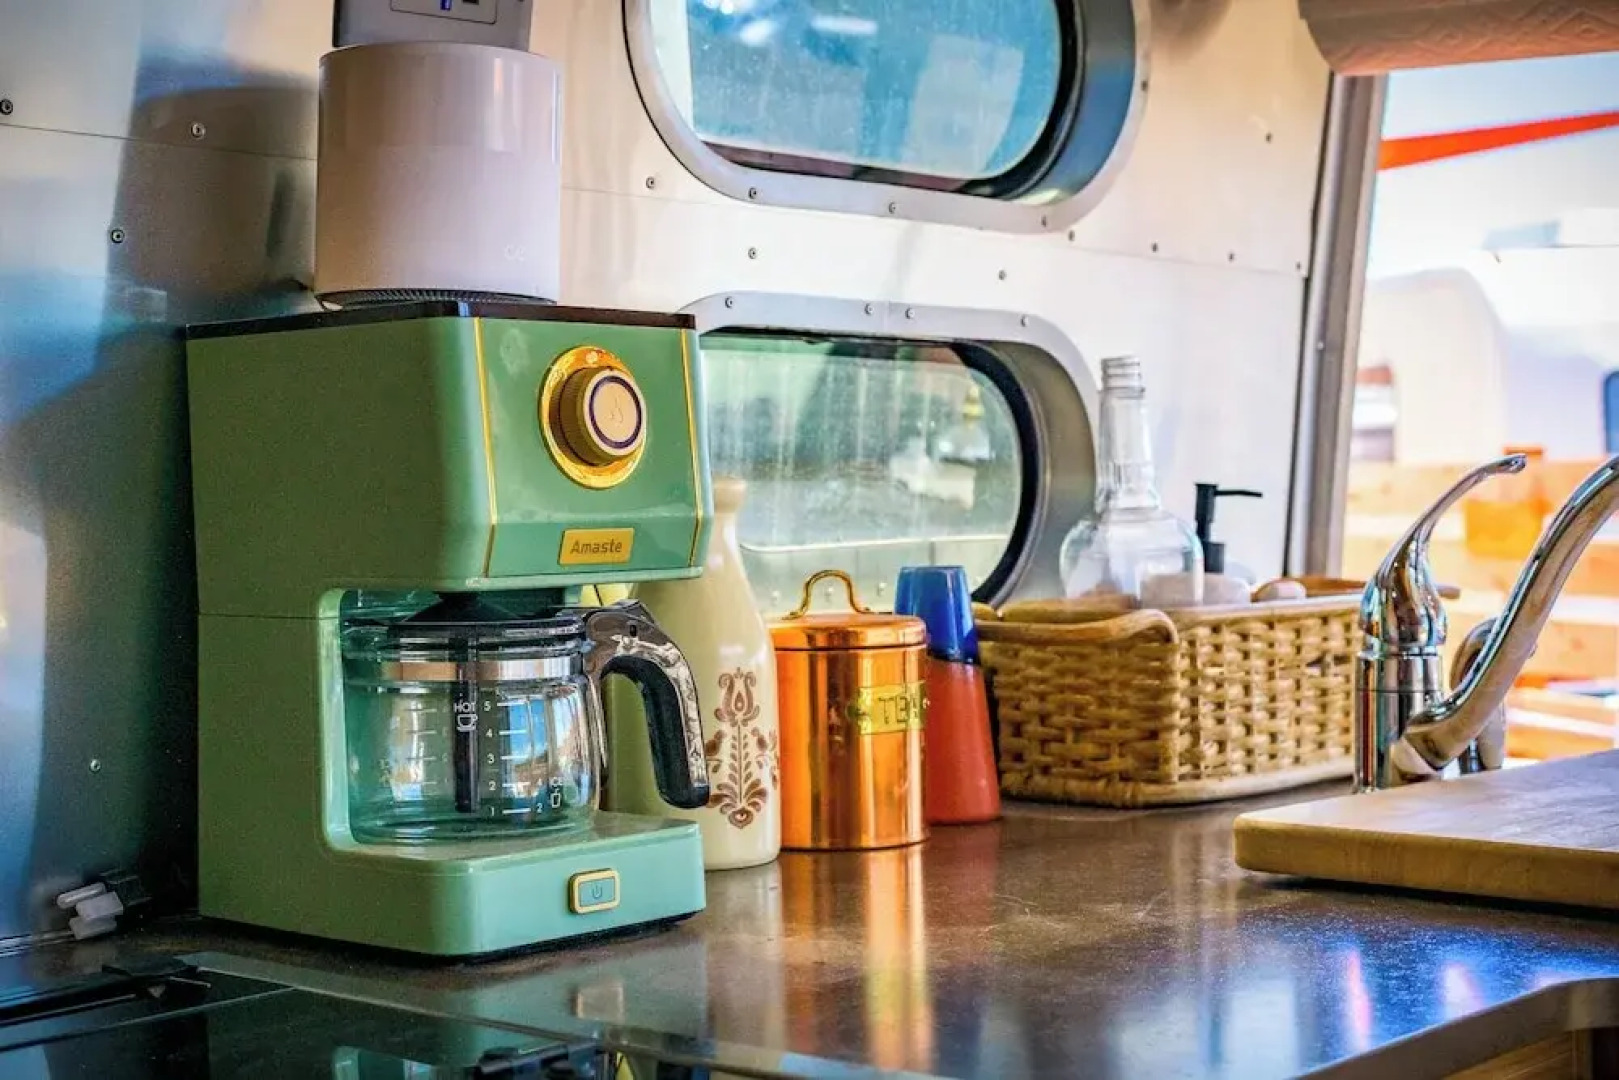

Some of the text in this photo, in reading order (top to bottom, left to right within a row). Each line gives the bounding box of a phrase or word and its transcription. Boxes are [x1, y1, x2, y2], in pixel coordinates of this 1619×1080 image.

[570, 539, 622, 554] Amaste
[453, 702, 475, 712] HOT
[483, 701, 491, 711] 5
[486, 728, 493, 738] 4
[487, 753, 495, 764] 3
[488, 780, 496, 790] 2
